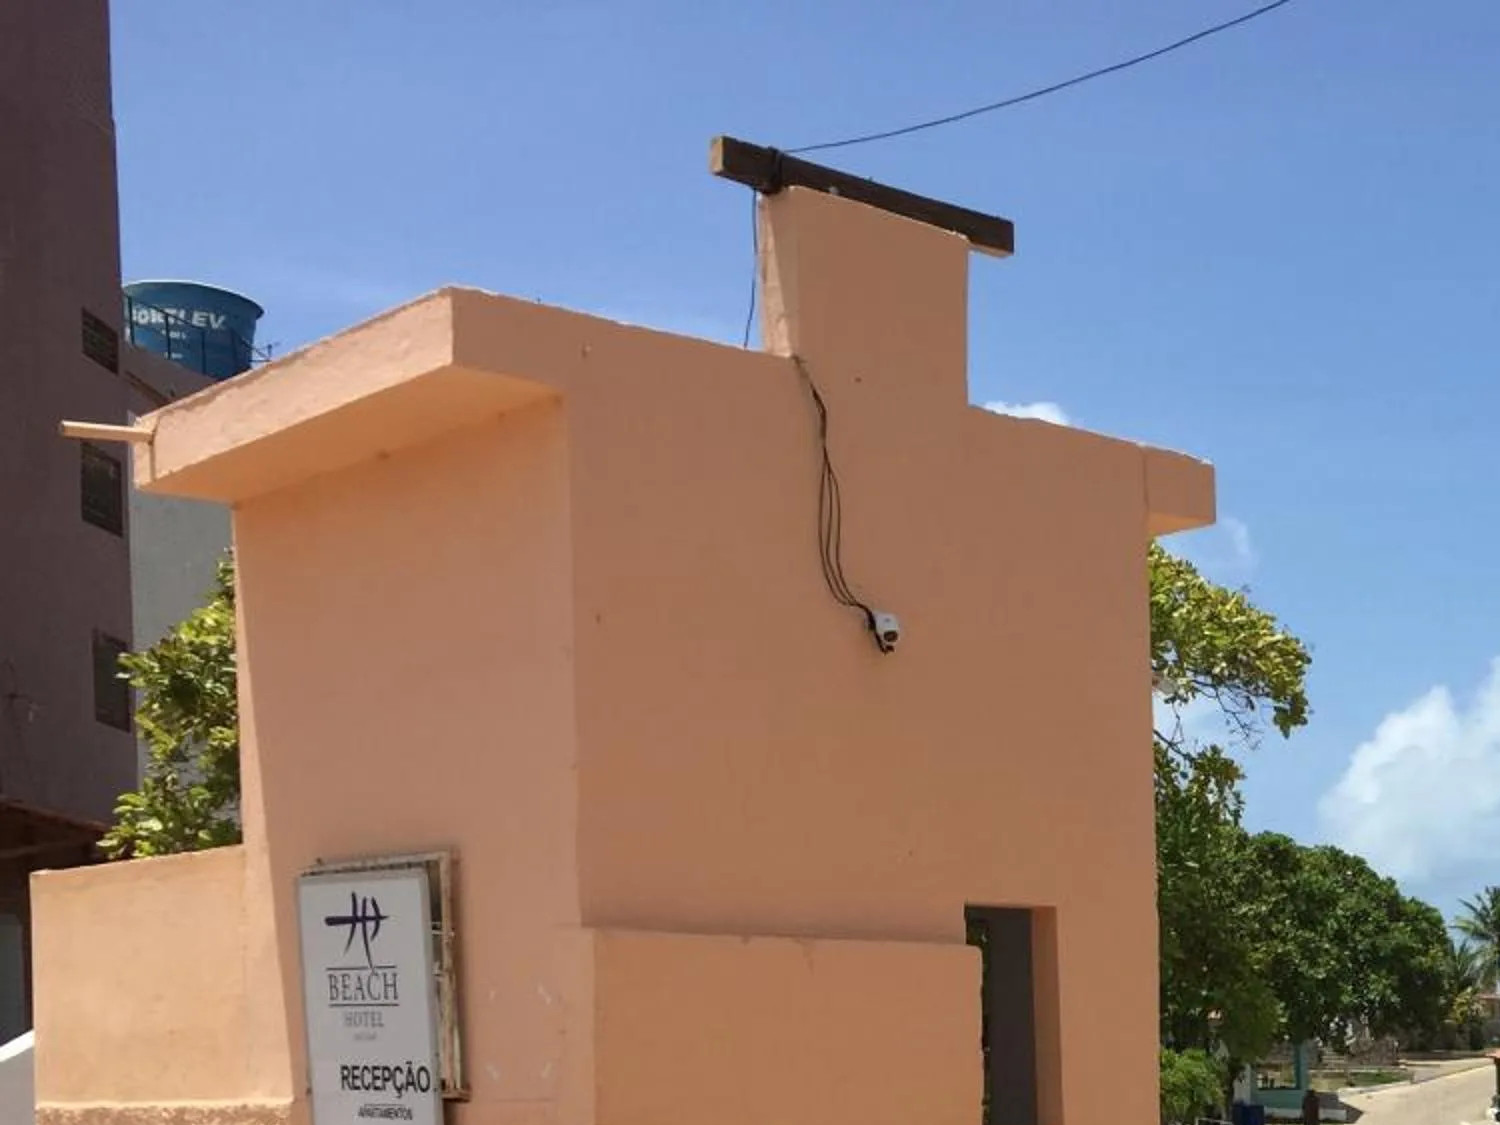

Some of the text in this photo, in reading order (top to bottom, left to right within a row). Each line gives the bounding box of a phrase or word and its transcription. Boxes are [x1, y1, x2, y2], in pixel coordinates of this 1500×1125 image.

[327, 971, 399, 1002] BEACH
[343, 1011, 385, 1028] HOTEL
[340, 1061, 431, 1099] RECEPÇÃO
